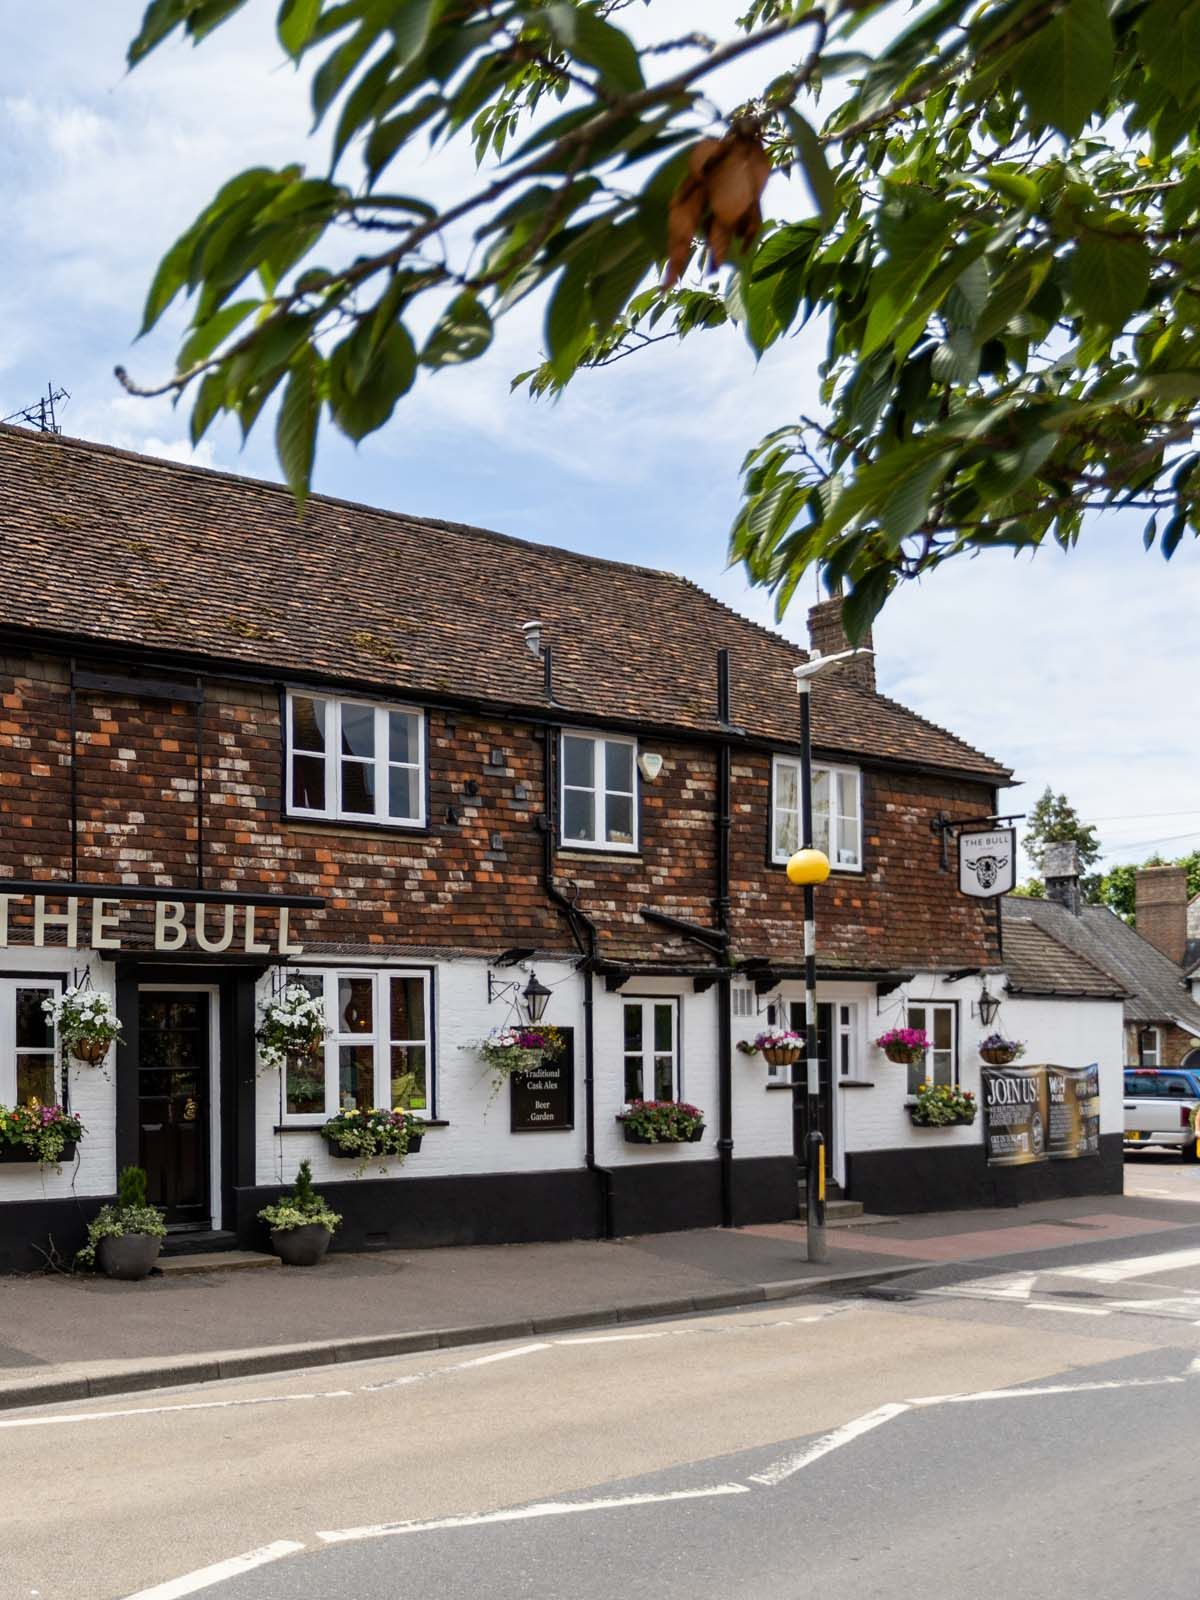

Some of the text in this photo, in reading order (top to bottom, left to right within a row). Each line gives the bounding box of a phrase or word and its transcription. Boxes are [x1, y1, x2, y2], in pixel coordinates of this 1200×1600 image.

[965, 836, 1008, 847] THE BULL
[155, 900, 304, 955] BULL
[525, 1068, 560, 1078] Traditional
[527, 1081, 558, 1090] Cask Ales
[987, 1078, 1040, 1105] JOIN US!
[535, 1101, 550, 1109] Beer
[530, 1112, 554, 1120] Garden
